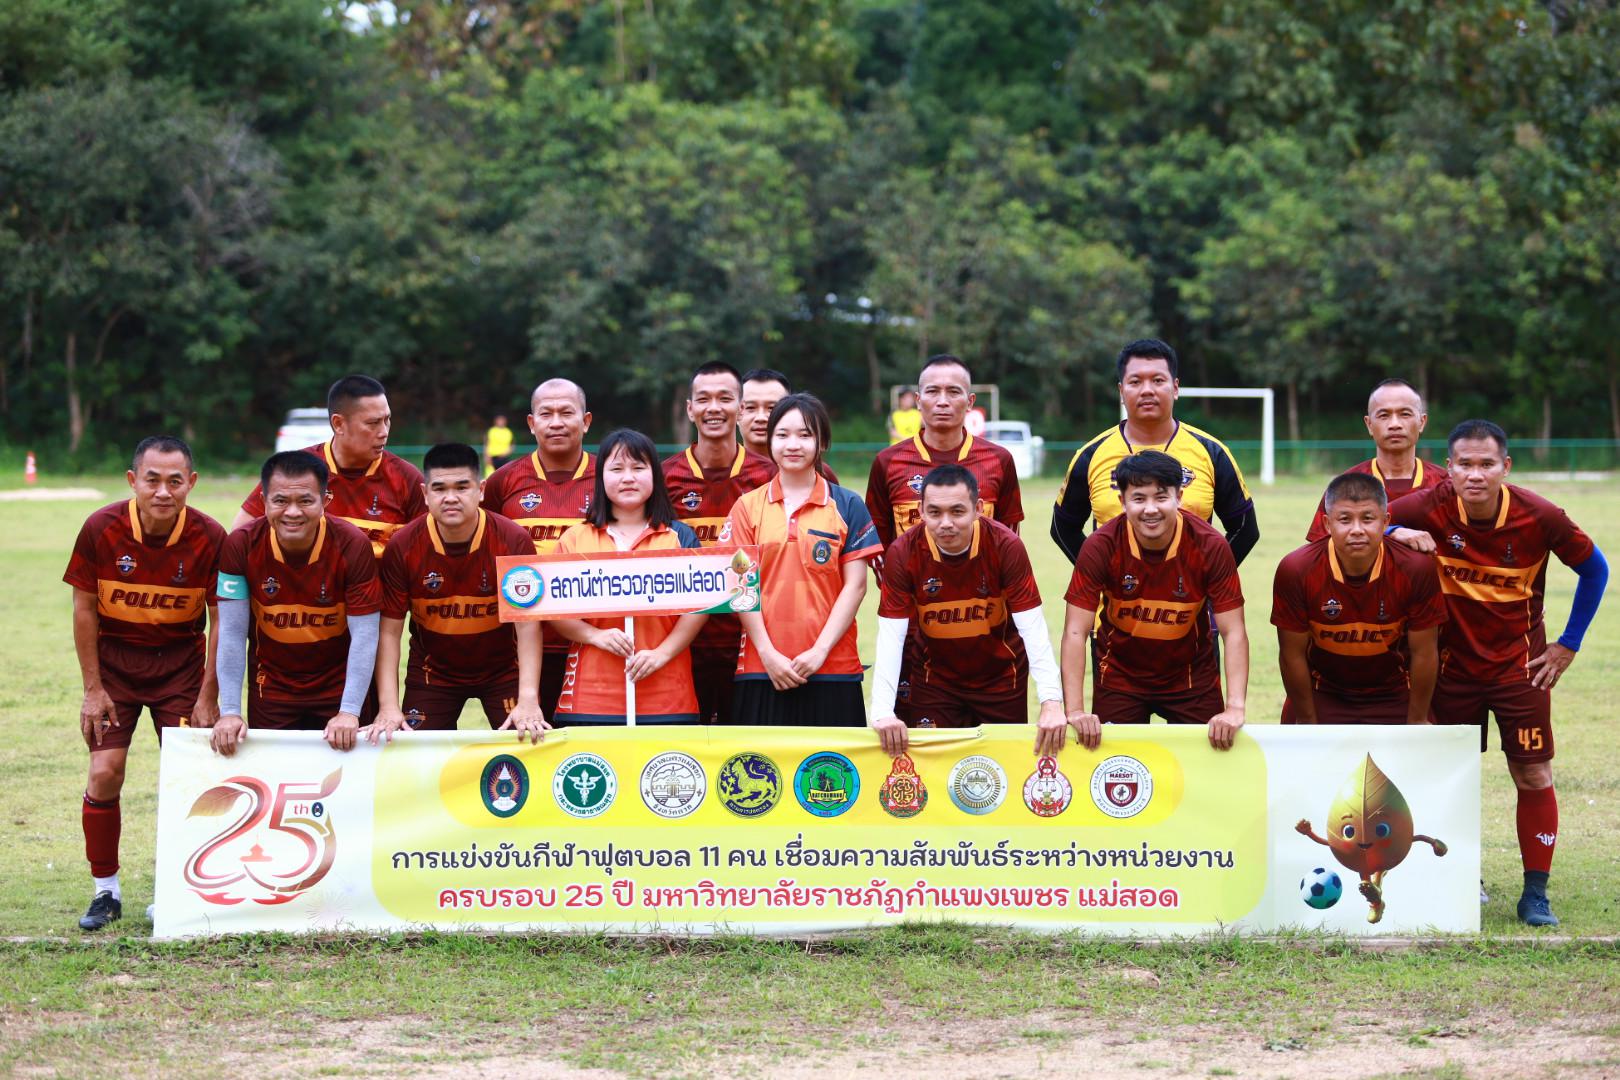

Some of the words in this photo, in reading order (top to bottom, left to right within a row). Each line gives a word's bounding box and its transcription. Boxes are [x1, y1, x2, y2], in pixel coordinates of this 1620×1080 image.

[223, 581, 239, 593] C
[551, 564, 726, 603] สถานีตำรวจภูธรแม่สอด
[1443, 564, 1520, 588] POLICE
[110, 588, 191, 610] POLICE
[263, 612, 339, 629] POLICE
[1118, 605, 1192, 626] POLICE
[1518, 727, 1544, 751] 45
[182, 770, 341, 900] 25
[293, 803, 309, 815] th
[392, 841, 691, 876] การแข่งขันกีฬาฟุตบอล
[699, 846, 719, 867] 11
[728, 849, 767, 867] คน
[775, 832, 1235, 868] เชื่อมความสัมพันธ์ระหว่างหน่วยงาน
[439, 888, 556, 908] ครบรอบ
[565, 884, 604, 908] 25
[611, 879, 634, 908] ปี
[642, 879, 1070, 914] มหาวิทยาลัยราชภัฏกำแพงเพชร
[1078, 880, 1179, 908] แม่สอด
